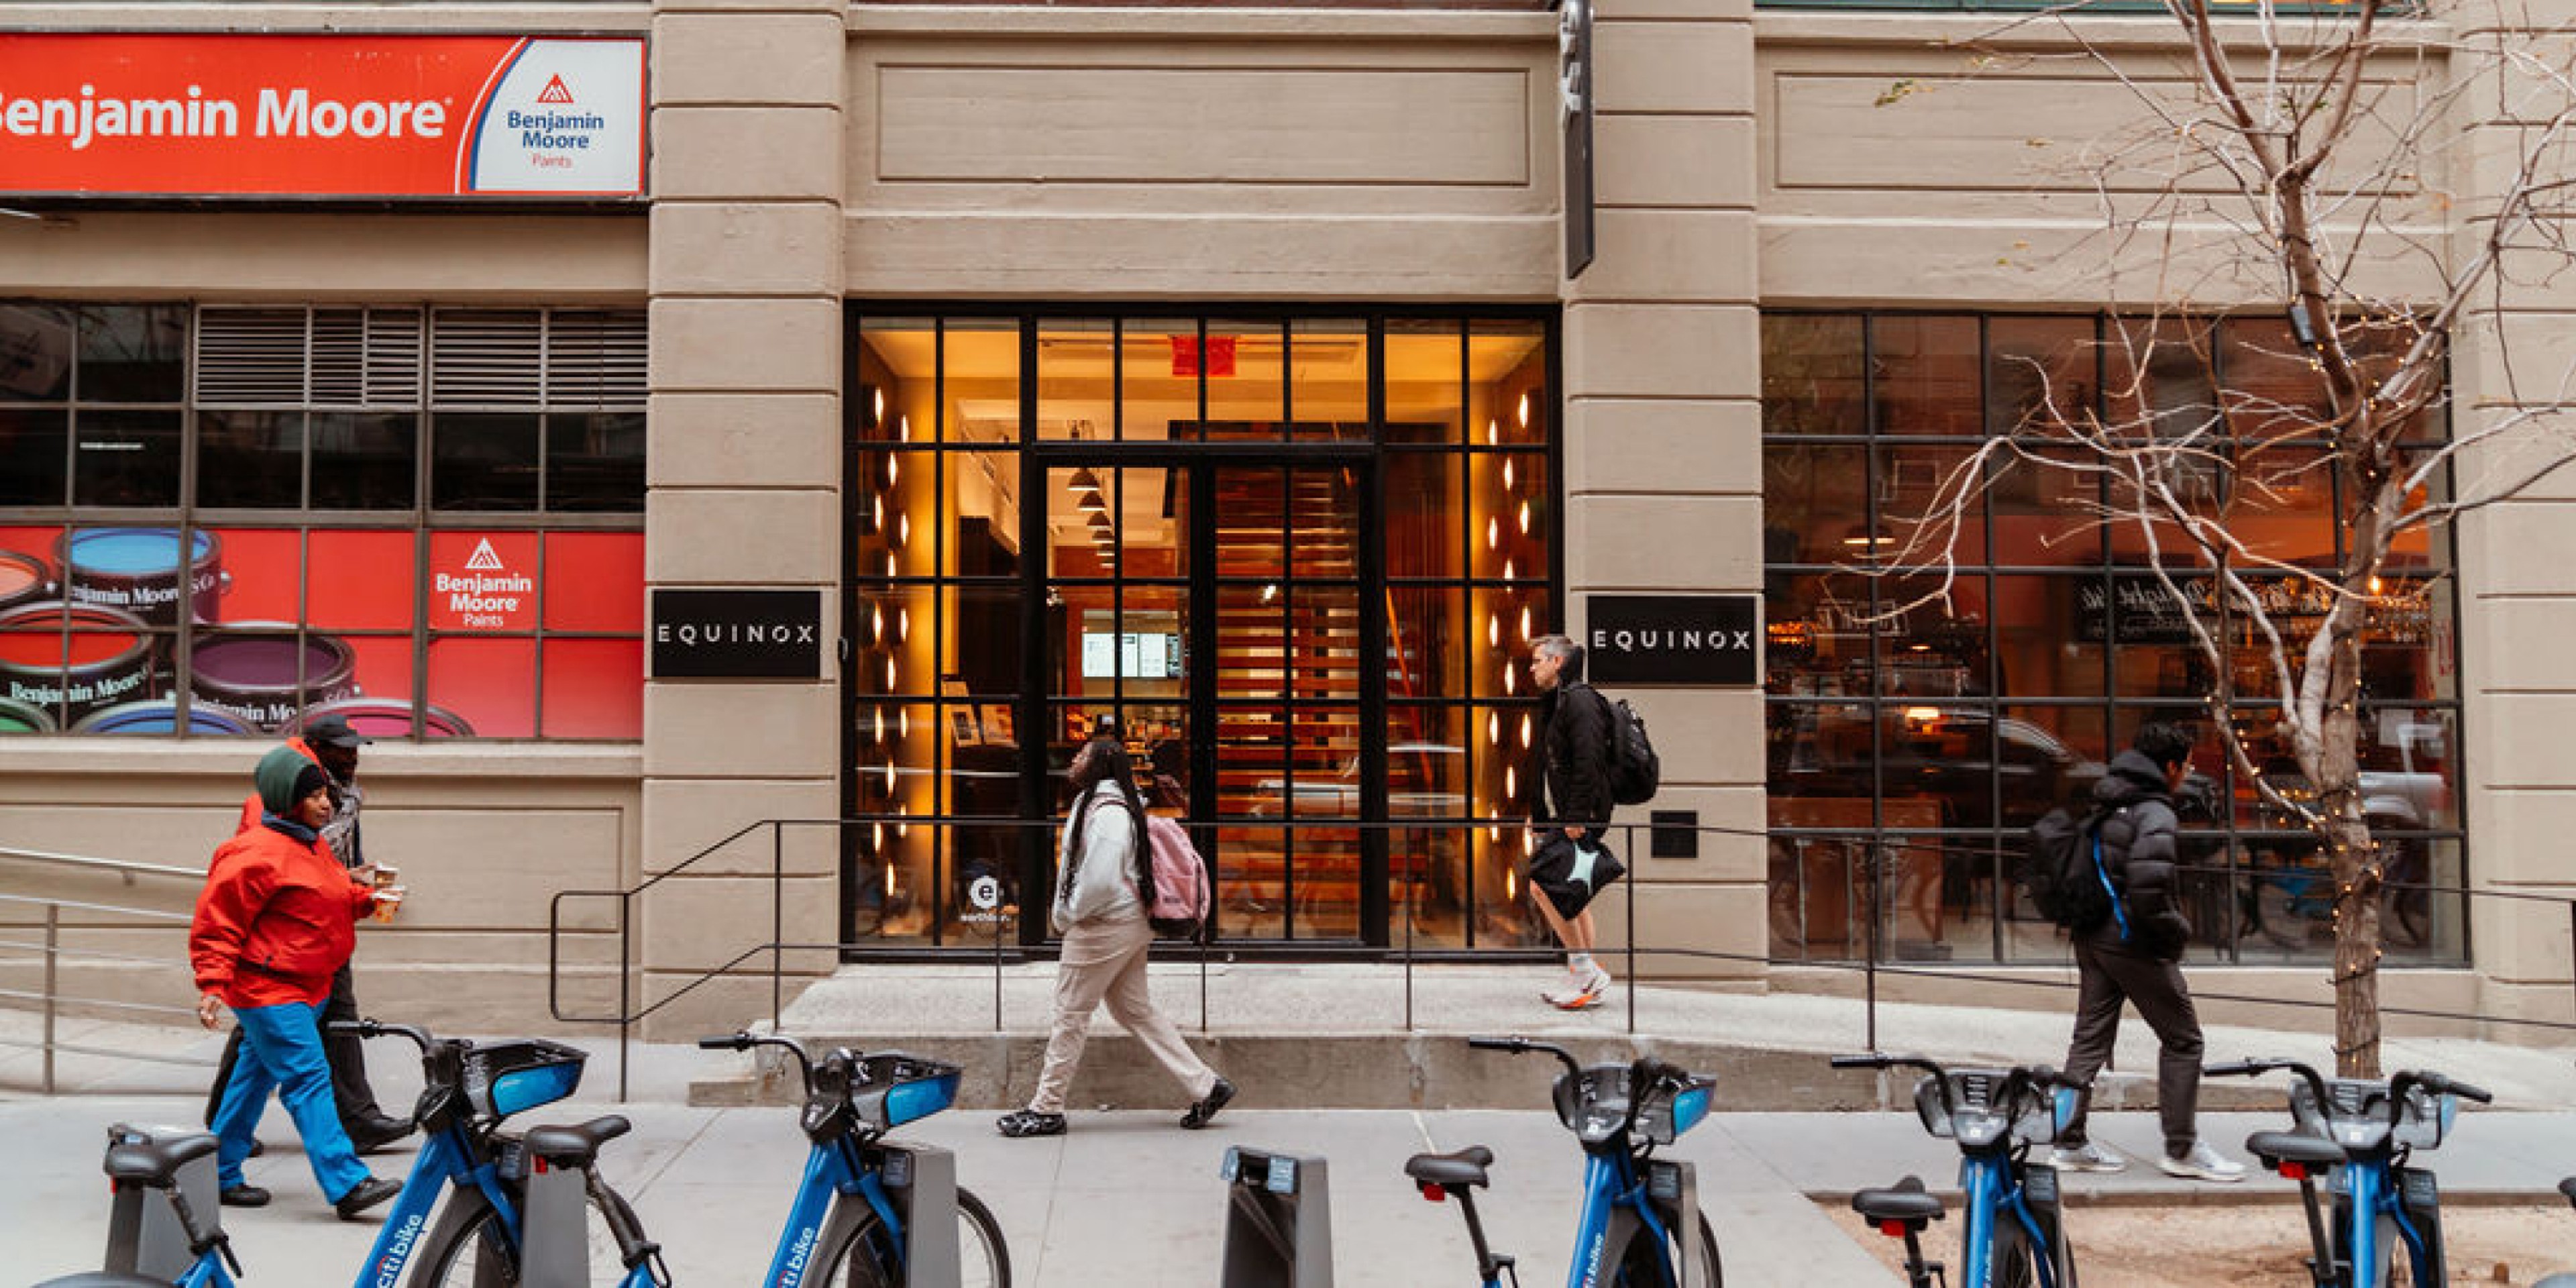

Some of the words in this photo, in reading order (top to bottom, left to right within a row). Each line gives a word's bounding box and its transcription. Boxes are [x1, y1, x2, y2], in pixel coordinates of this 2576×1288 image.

[0, 82, 237, 150] enjamin
[256, 87, 445, 138] Moore
[507, 110, 604, 133] Benjamin
[523, 130, 589, 148] Moore
[533, 152, 572, 168] Paints
[133, 586, 178, 604] Moor
[437, 572, 532, 596] Benjamin
[450, 593, 517, 612] Moore
[463, 613, 503, 627] Paints
[658, 623, 813, 646] EQUINOX
[1593, 629, 1750, 652] EQUINOX
[388, 1213, 424, 1256] bike
[786, 1227, 816, 1271] bike
